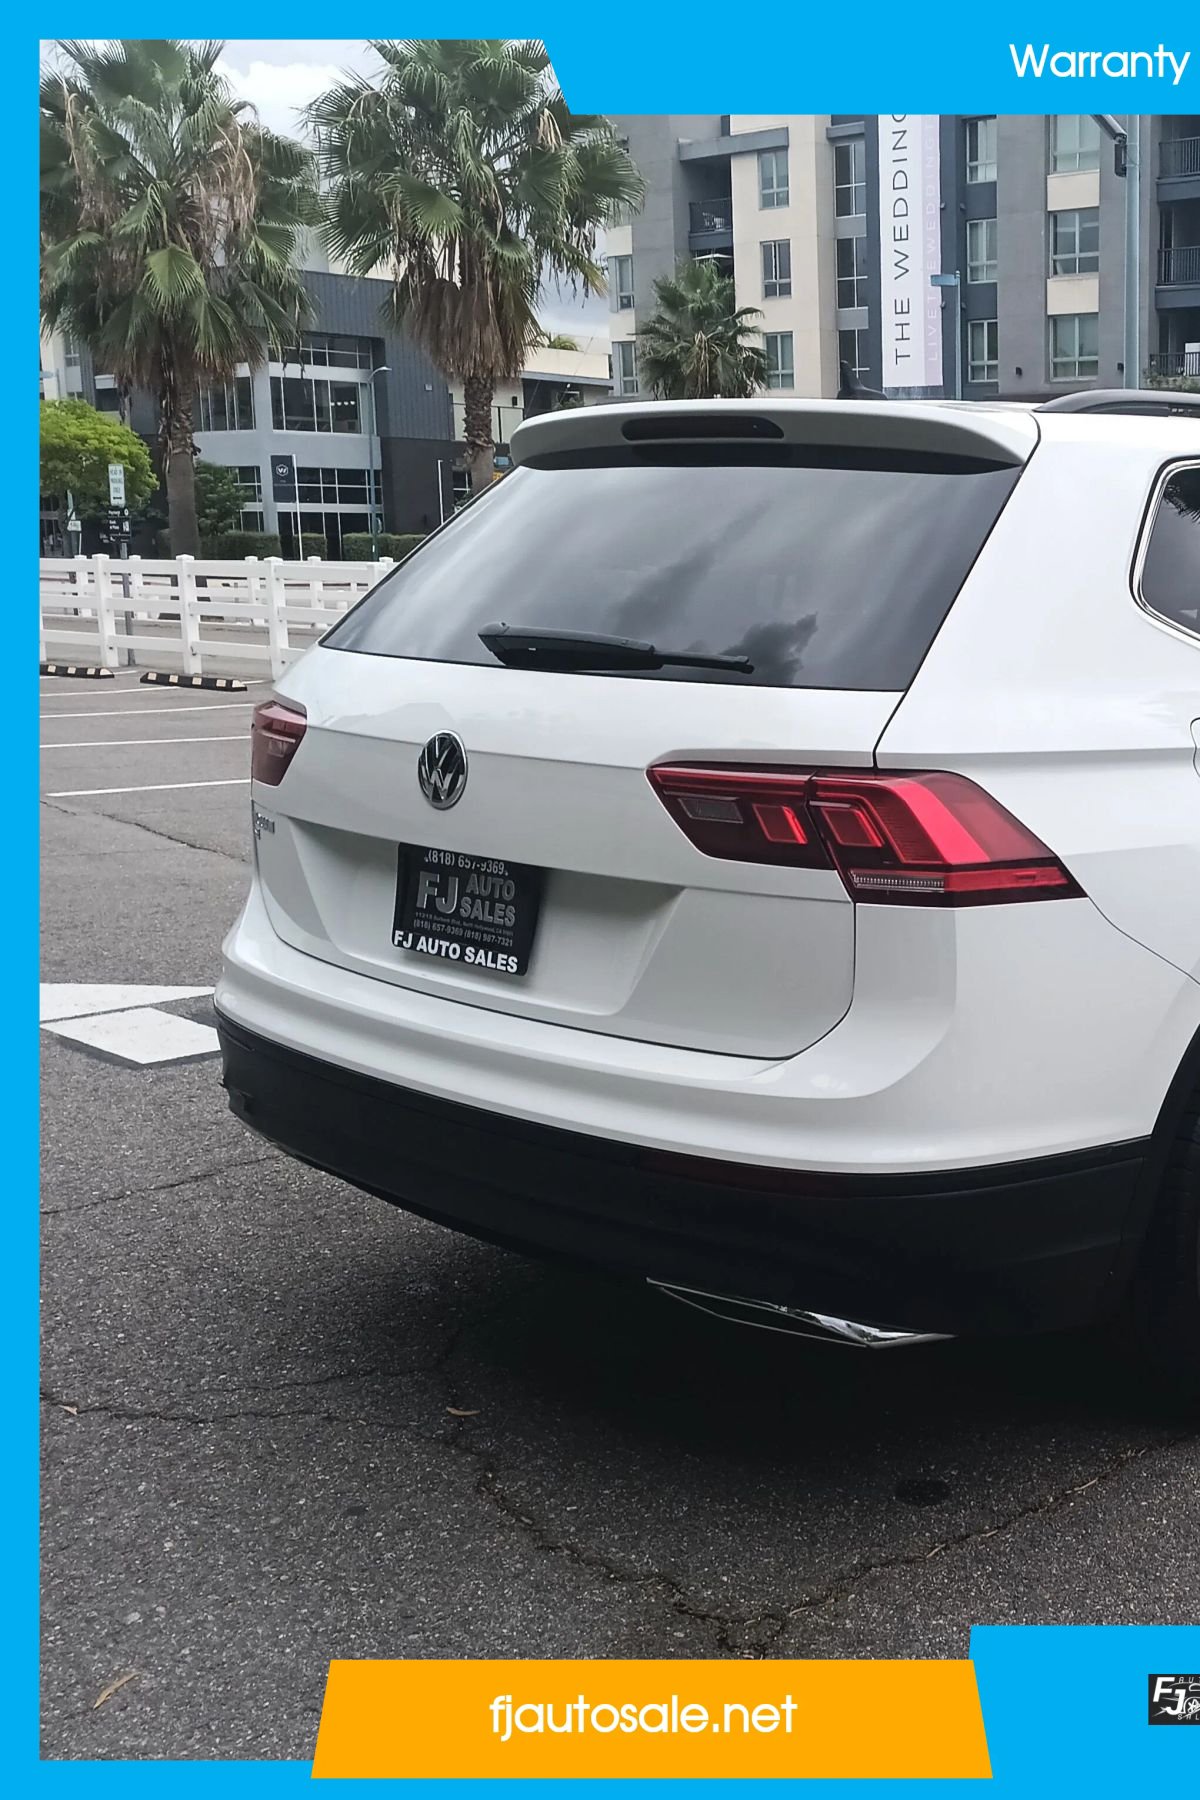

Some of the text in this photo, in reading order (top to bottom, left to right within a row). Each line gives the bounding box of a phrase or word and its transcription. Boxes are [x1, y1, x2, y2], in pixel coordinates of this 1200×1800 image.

[894, 297, 911, 365] THE
[428, 849, 455, 866] (818)
[416, 870, 516, 914] FJ AUTO
[459, 896, 516, 927] SALES
[393, 929, 518, 973] FJ AUTO SALES
